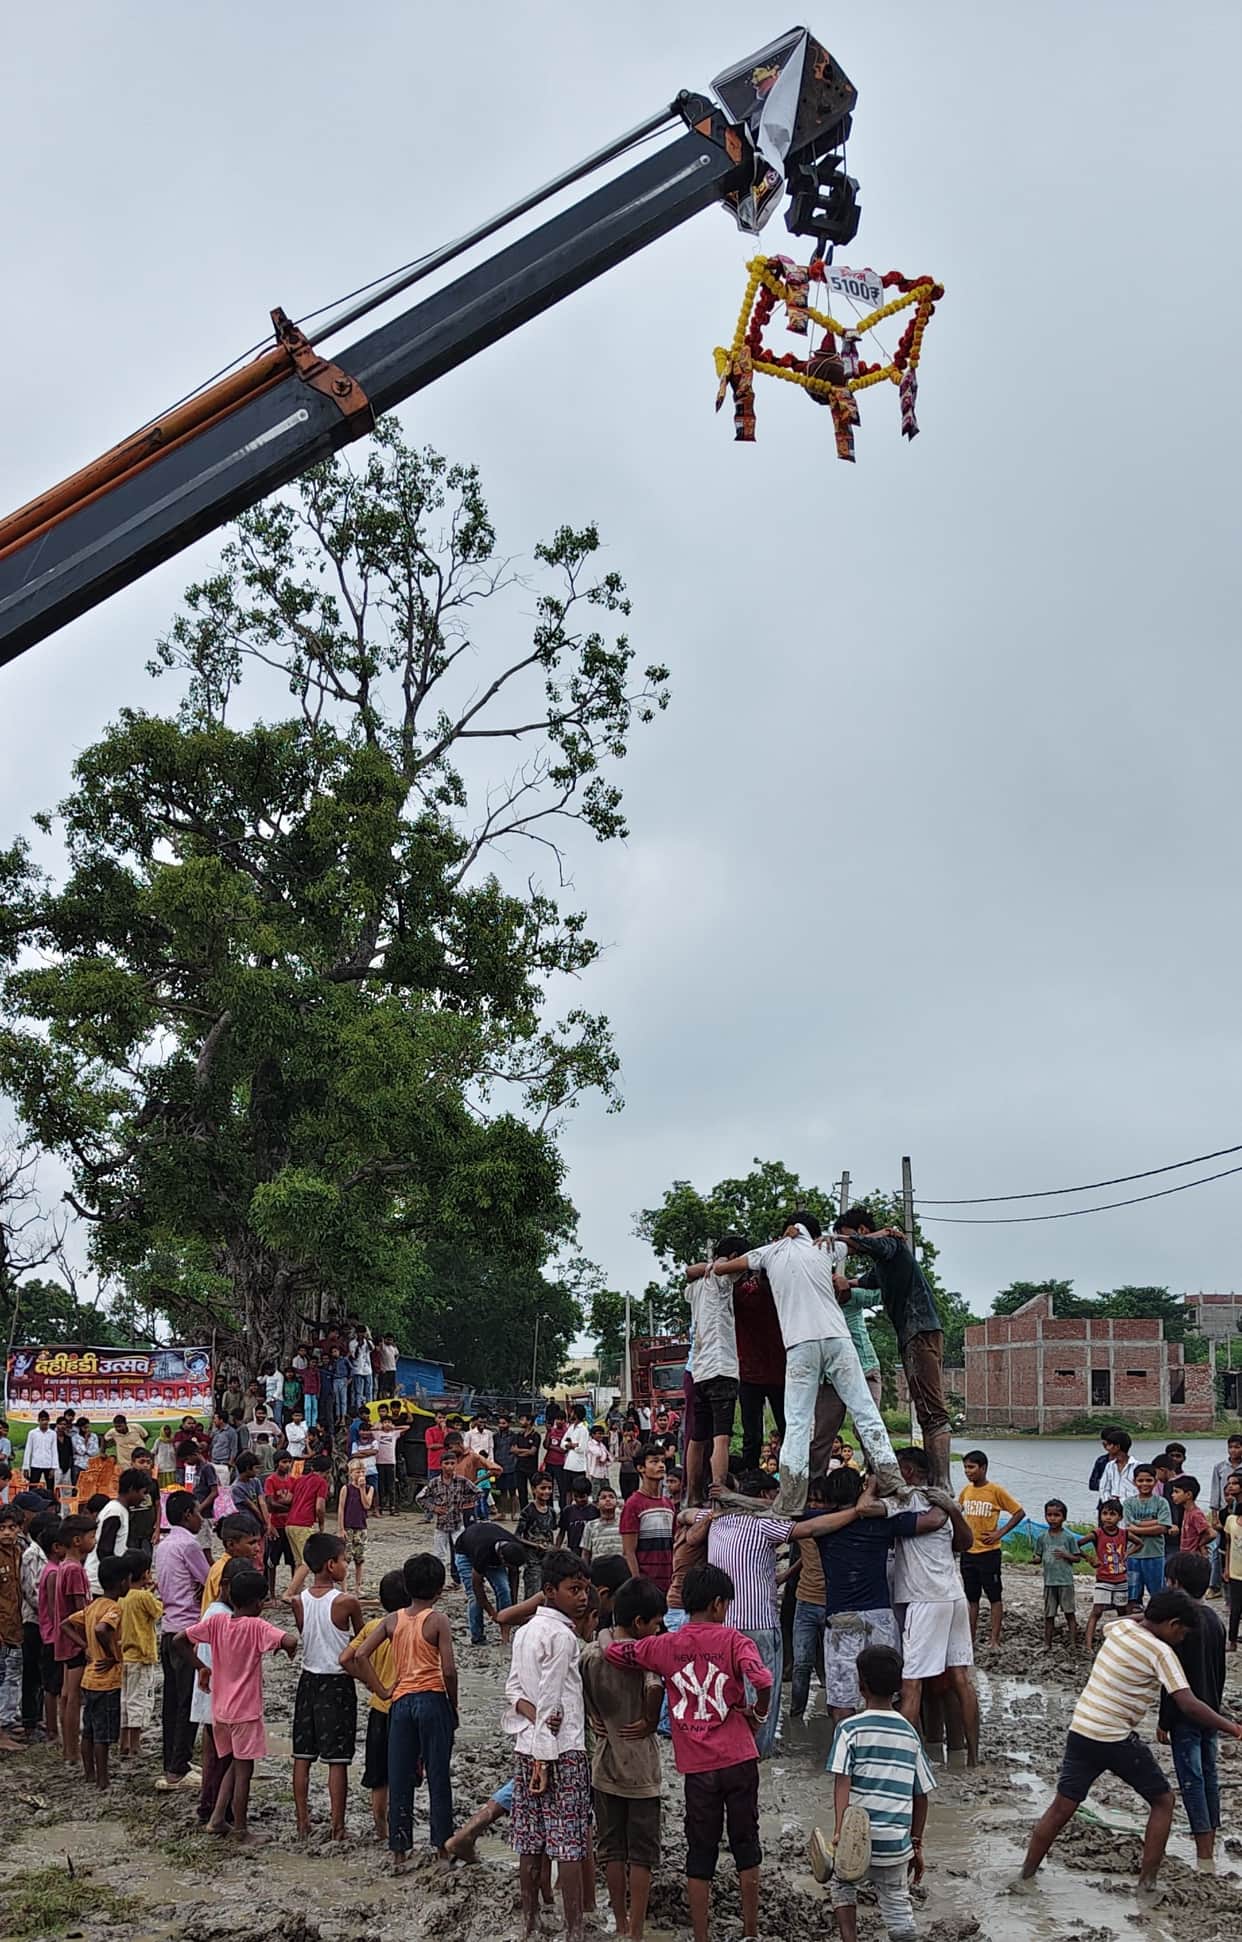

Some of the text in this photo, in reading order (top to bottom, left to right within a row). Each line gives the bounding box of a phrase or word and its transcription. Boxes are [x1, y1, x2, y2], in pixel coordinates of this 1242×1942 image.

[35, 1352, 150, 1375] दहीहंडी उत्सव
[673, 1652, 725, 1662] NEW YORK
